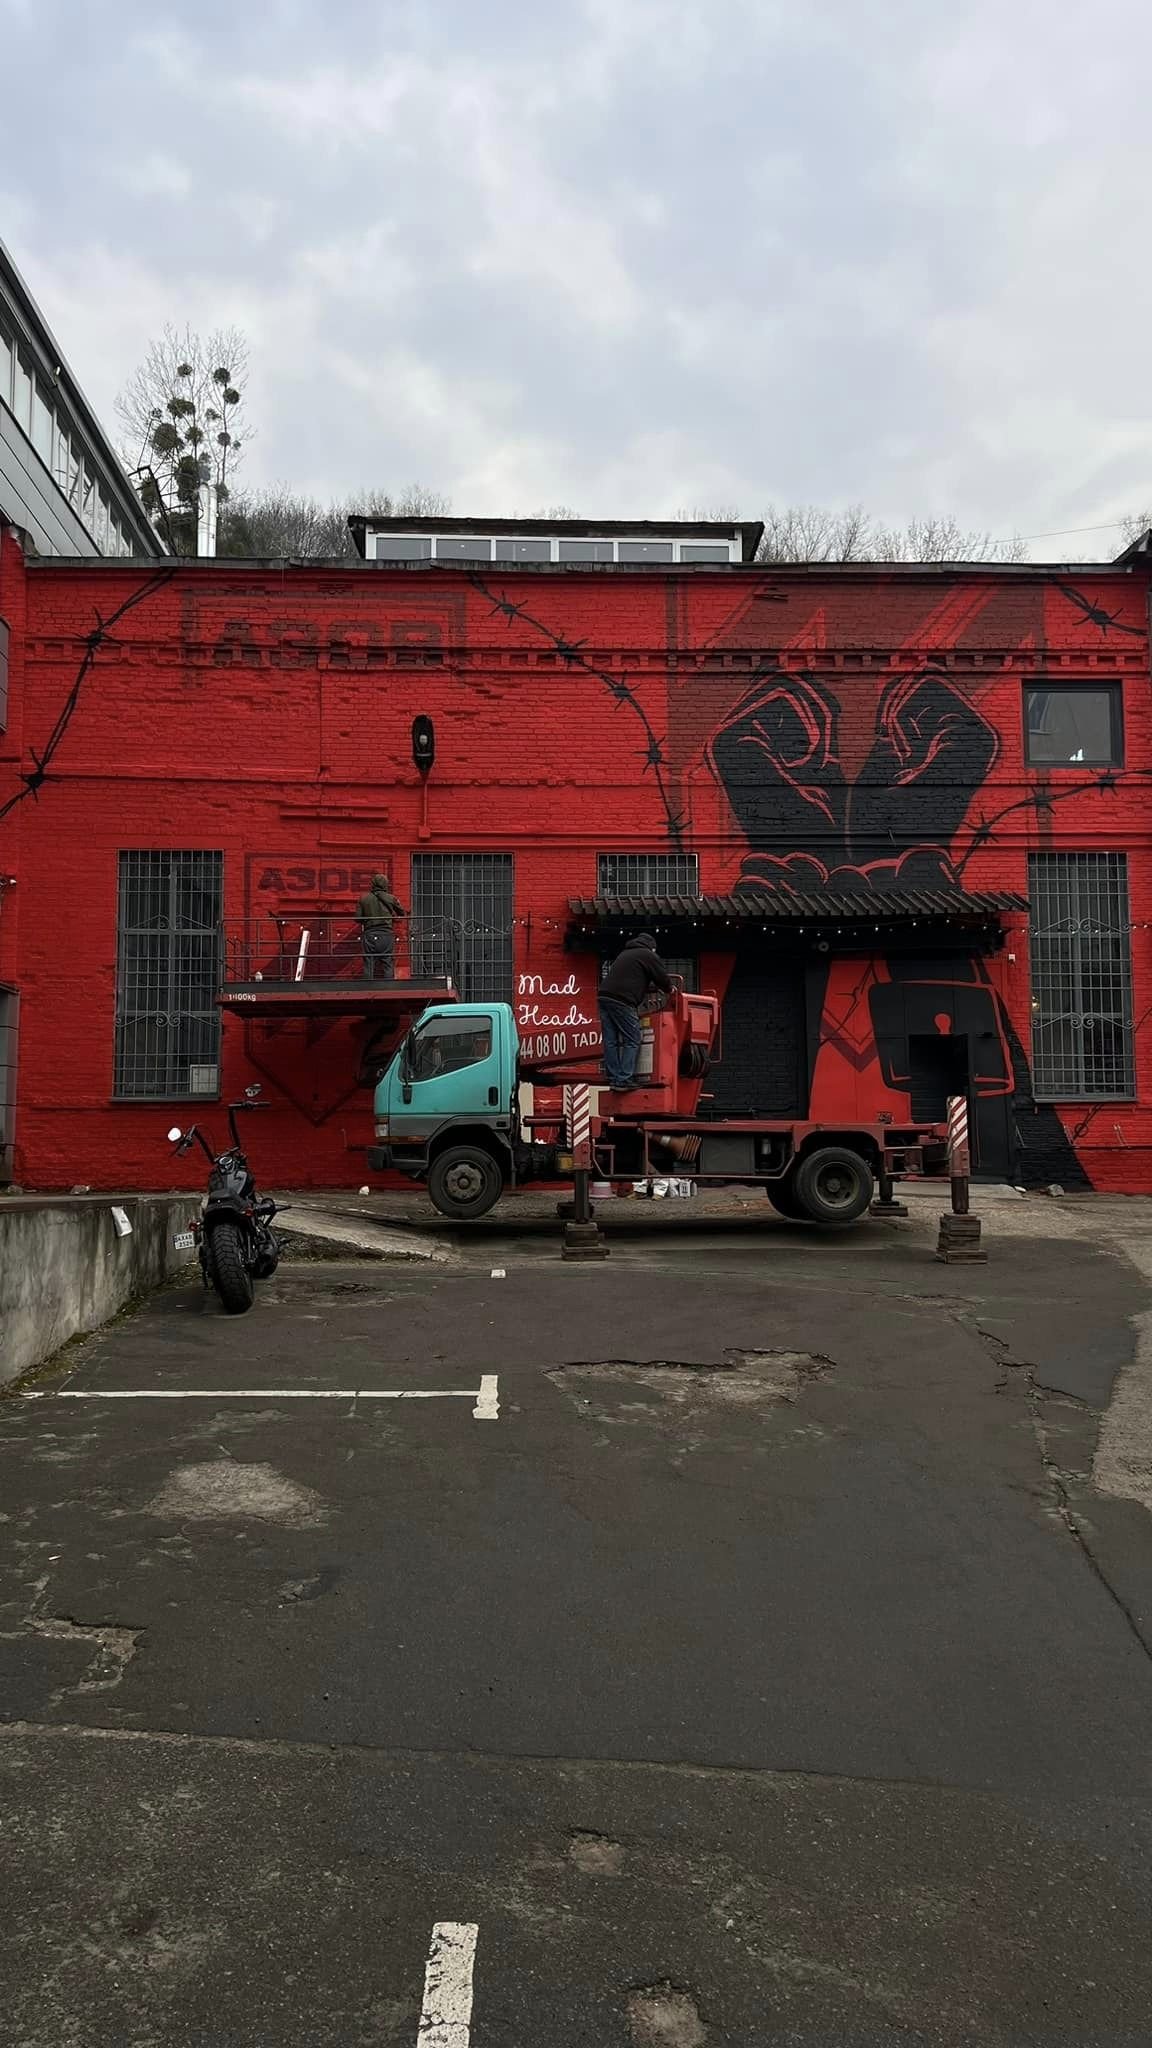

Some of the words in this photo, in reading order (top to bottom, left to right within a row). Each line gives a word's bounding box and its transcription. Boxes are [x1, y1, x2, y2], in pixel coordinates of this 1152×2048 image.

[518, 974, 581, 996] Mad
[518, 1004, 593, 1026] Heads
[536, 1034, 550, 1058] 08
[553, 1032, 567, 1056] 00
